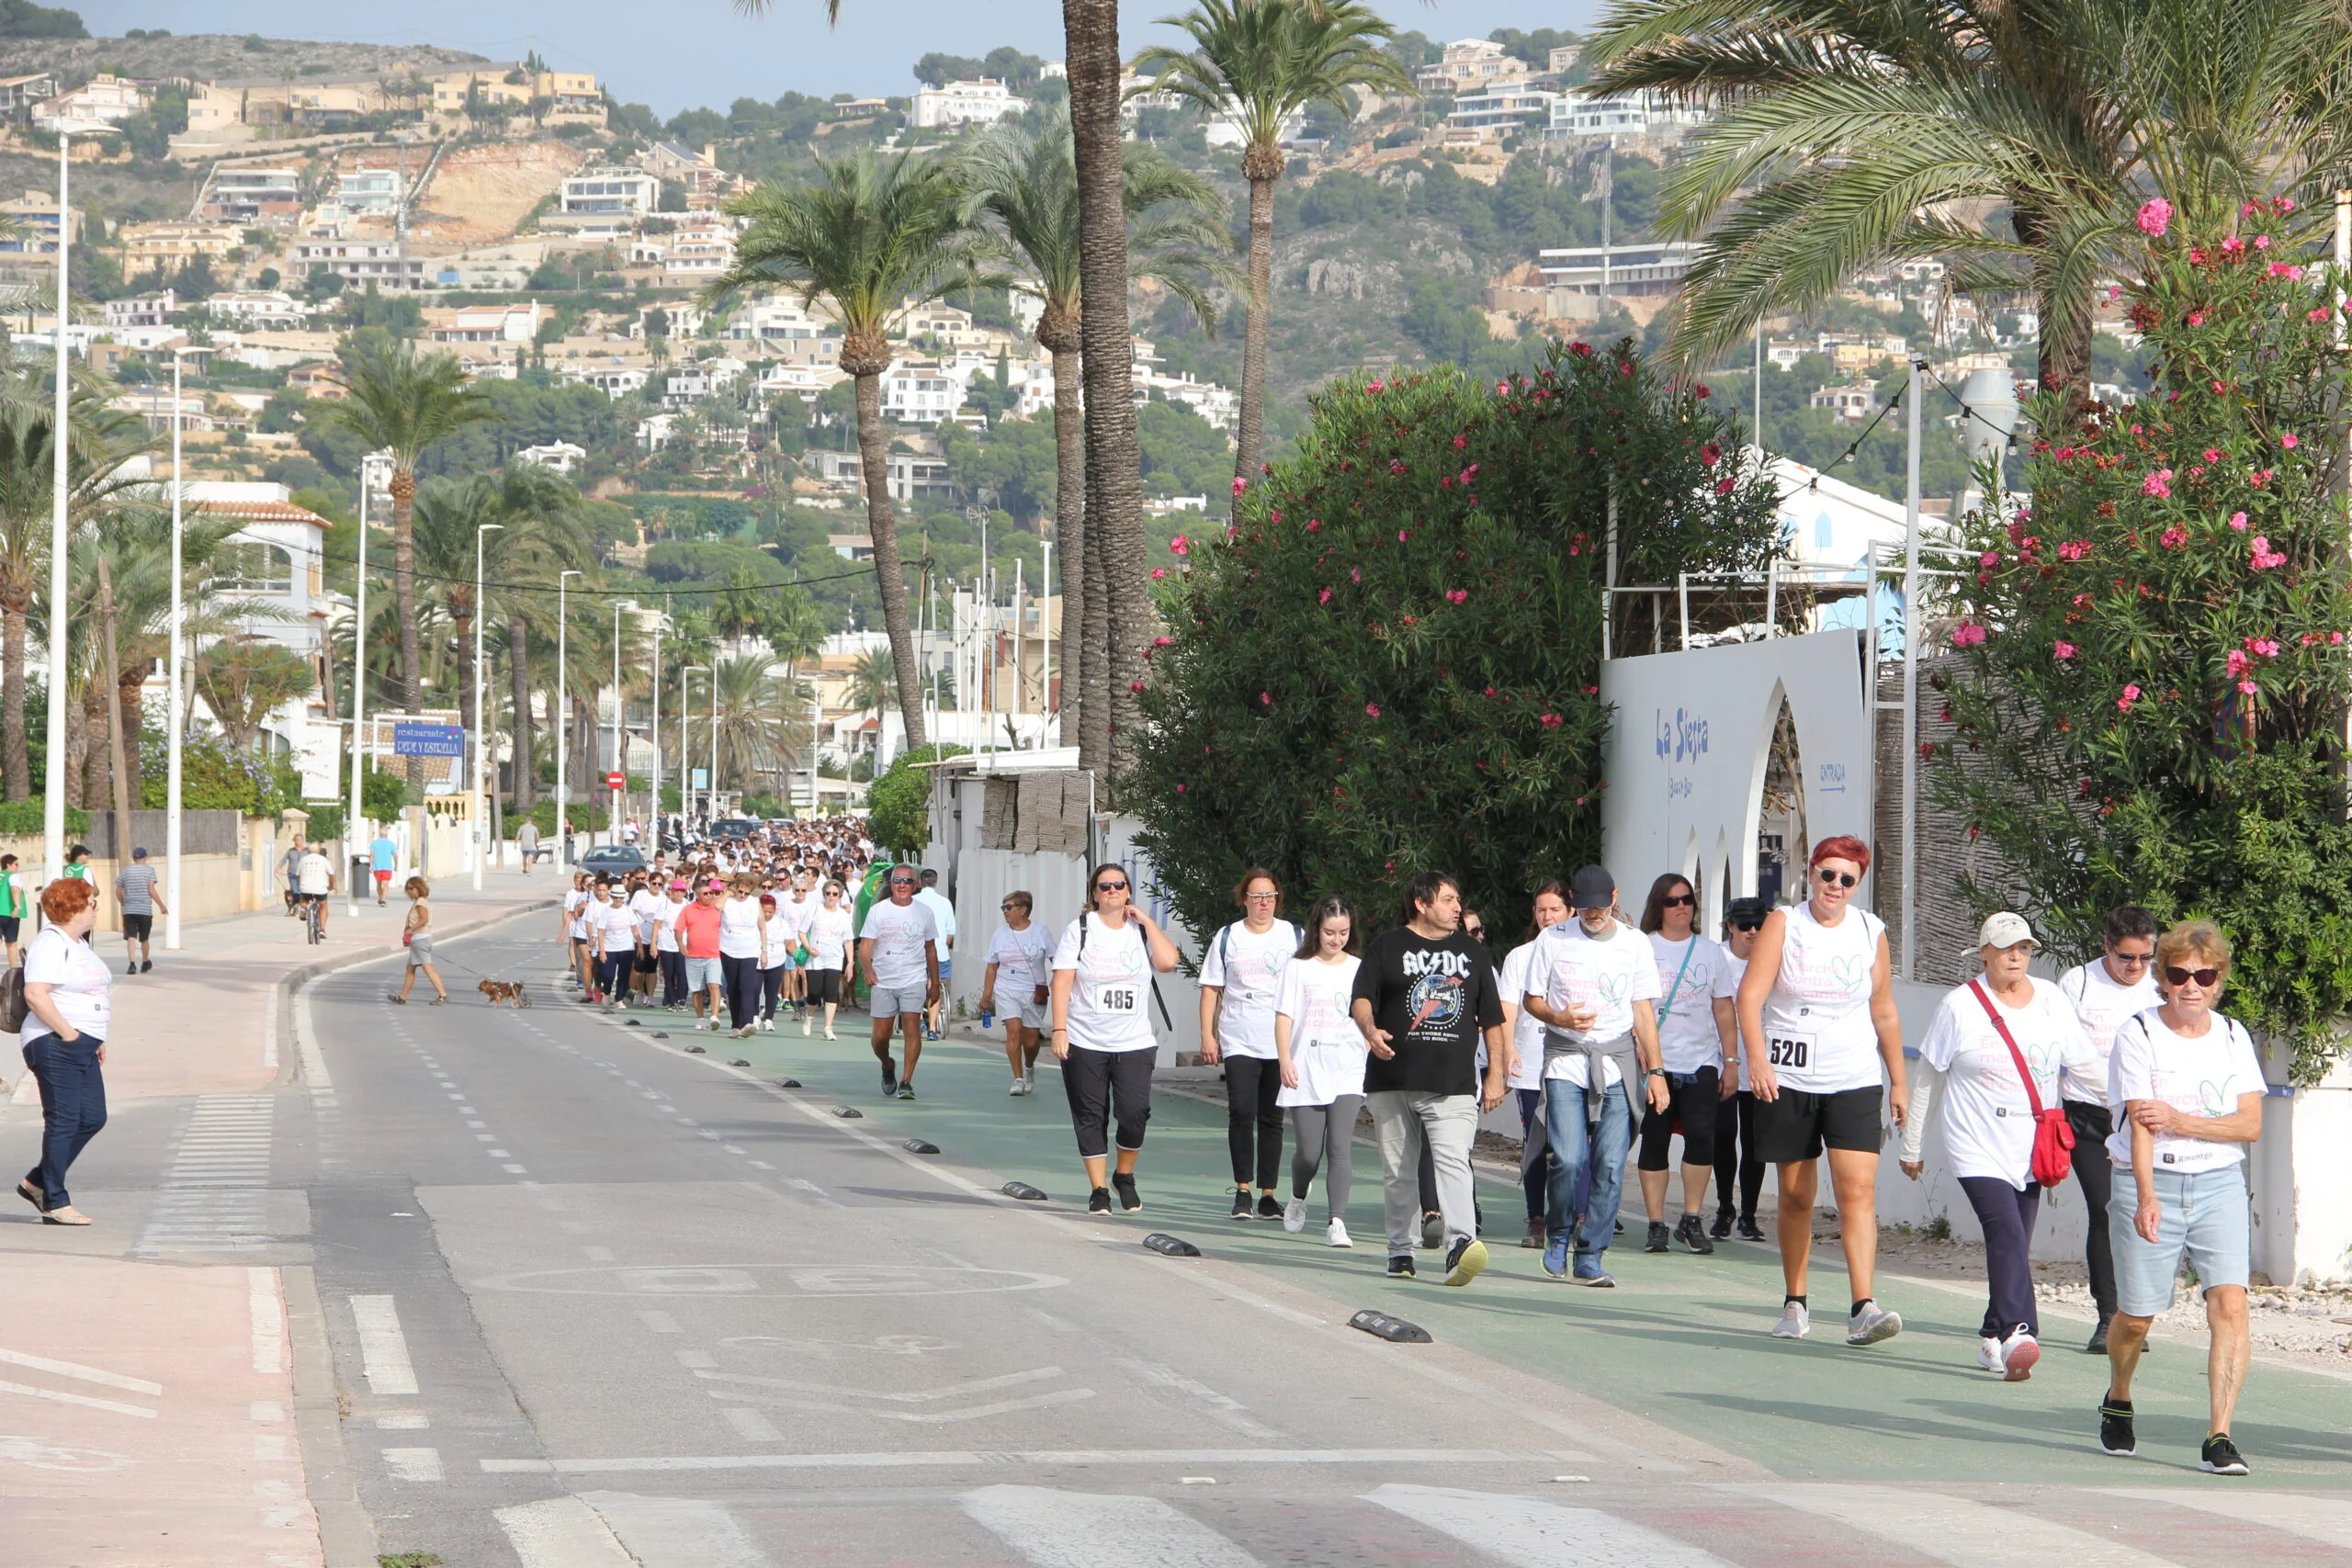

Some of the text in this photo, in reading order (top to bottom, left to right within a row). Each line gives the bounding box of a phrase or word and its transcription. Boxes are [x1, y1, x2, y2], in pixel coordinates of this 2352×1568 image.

[398, 728, 446, 738] restaurante
[1657, 707, 1709, 764] La Siesta
[398, 740, 458, 754] PEPE Y ESTRELLA
[1820, 763, 1846, 782] ENTRADA
[1787, 974, 1834, 987] contra
[1103, 989, 1134, 1010] 485
[1770, 1038, 1807, 1068] 520
[2178, 1152, 2213, 1164] Rimontgo
